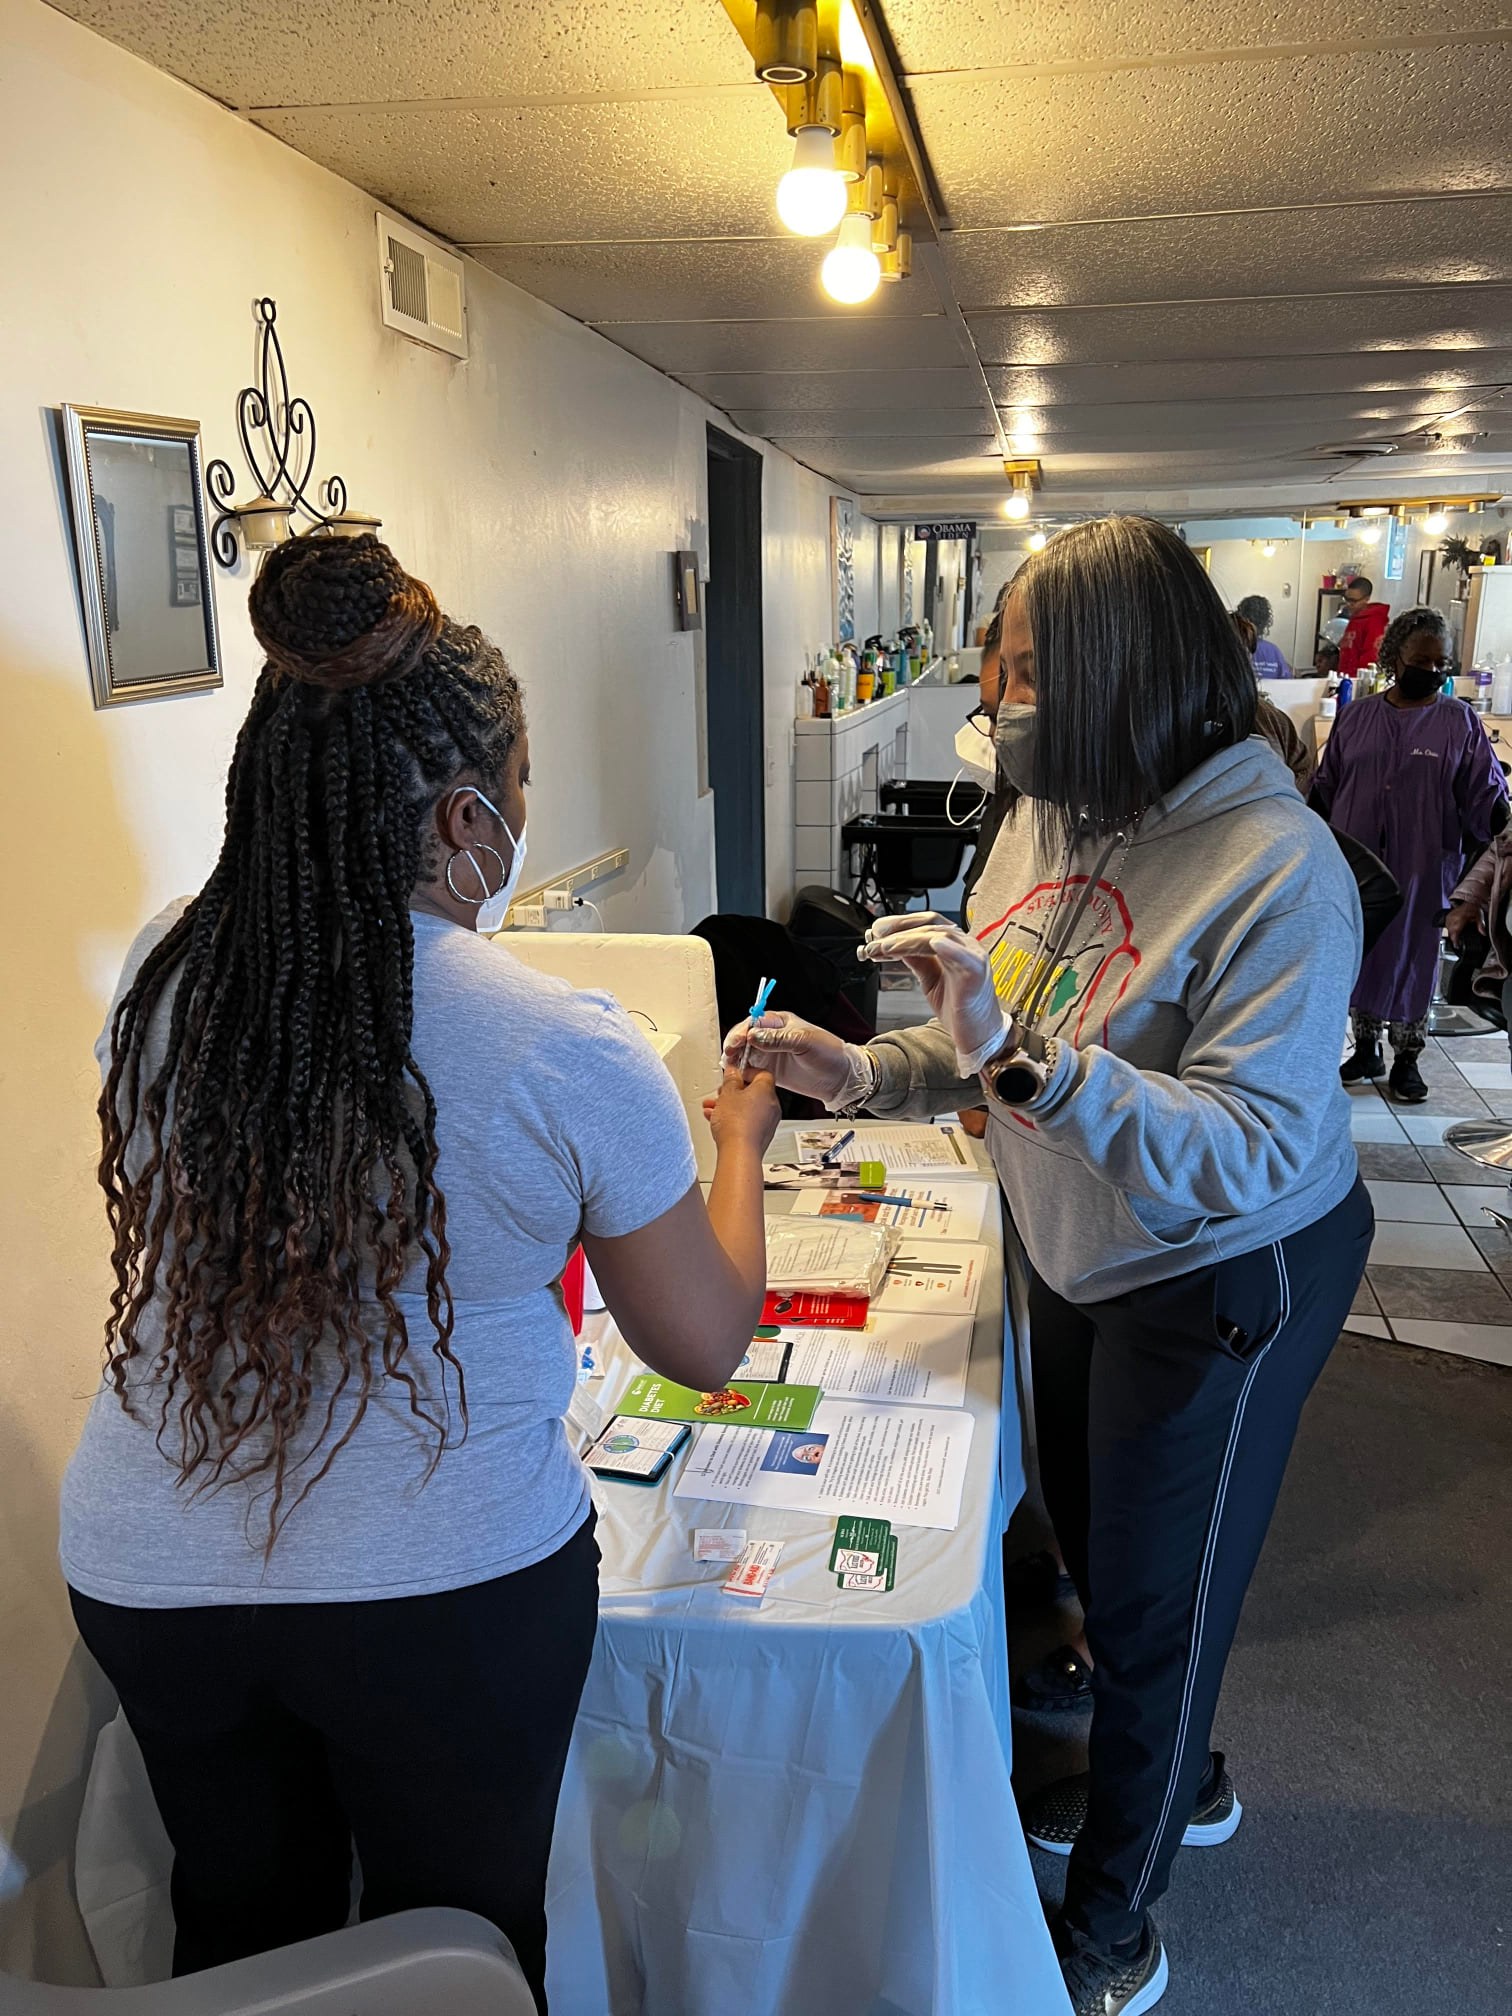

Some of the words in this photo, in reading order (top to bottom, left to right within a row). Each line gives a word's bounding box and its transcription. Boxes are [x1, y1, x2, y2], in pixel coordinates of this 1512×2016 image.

[932, 523, 972, 534] OBAMA
[936, 532, 969, 540] BIDEN
[638, 1383, 662, 1412] DIABETES
[650, 1399, 665, 1413] DIET
